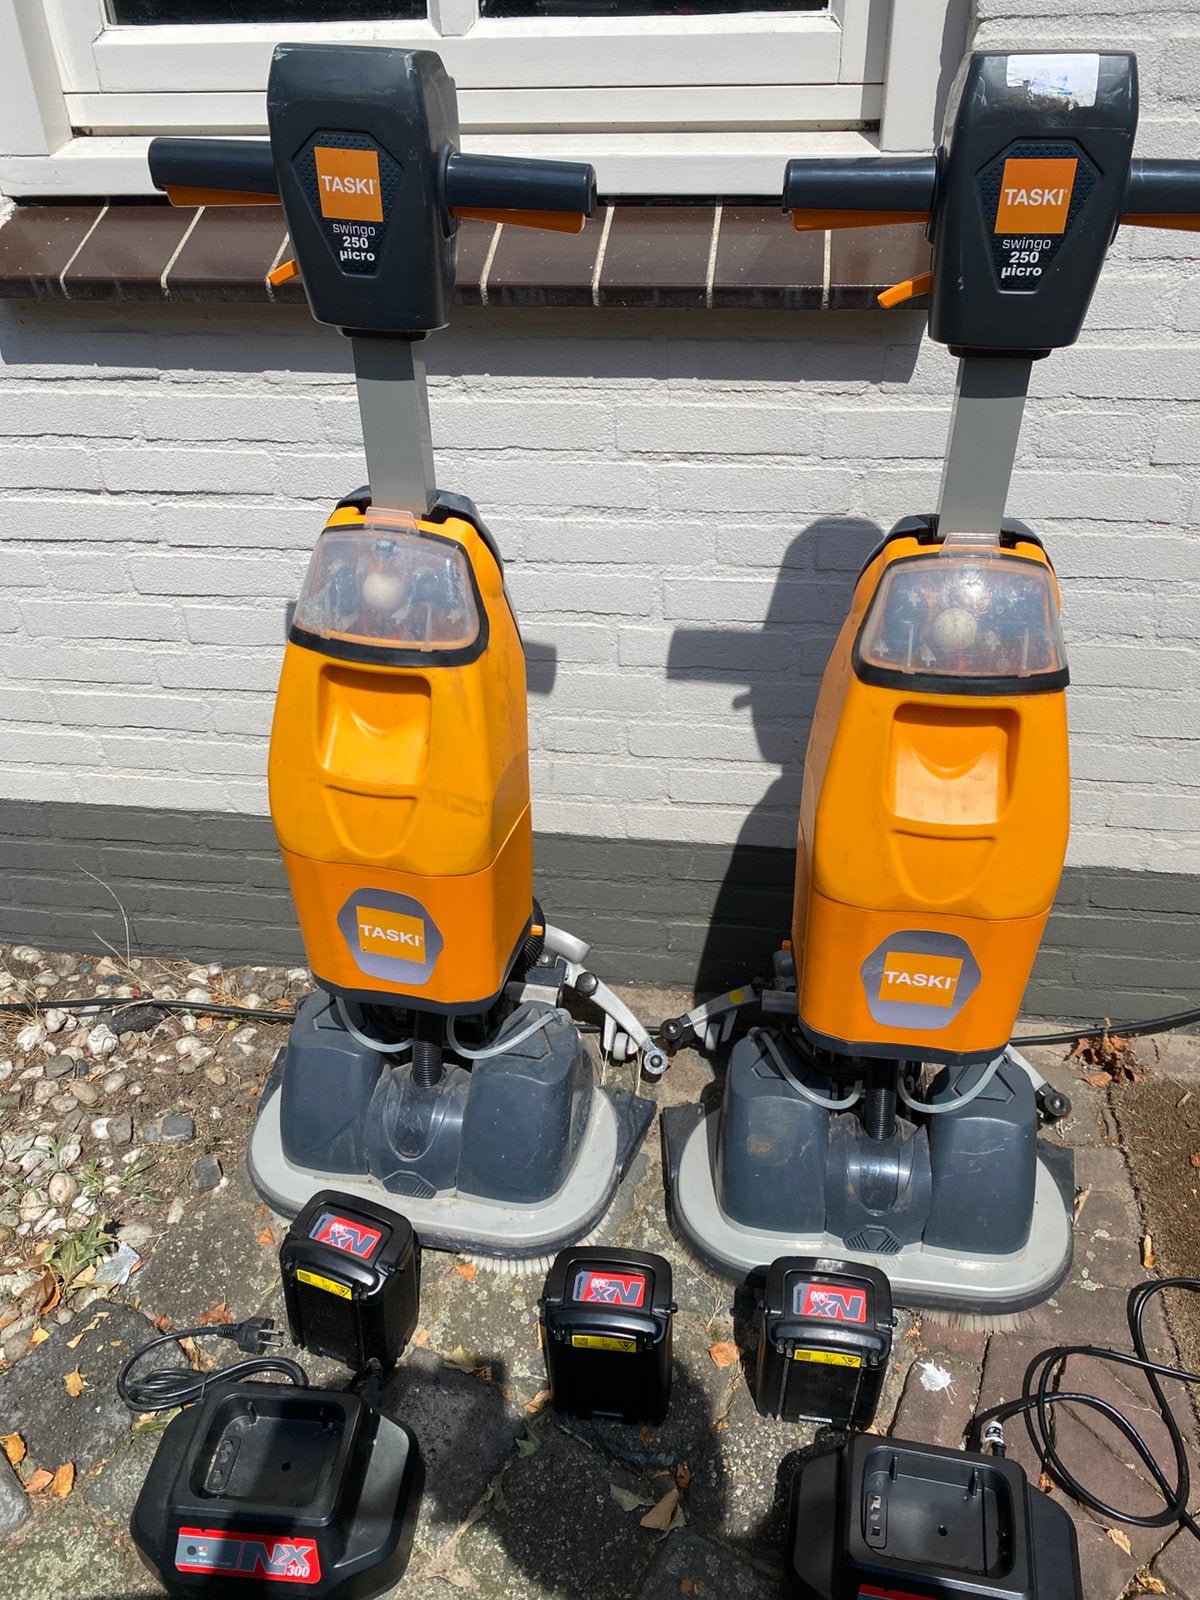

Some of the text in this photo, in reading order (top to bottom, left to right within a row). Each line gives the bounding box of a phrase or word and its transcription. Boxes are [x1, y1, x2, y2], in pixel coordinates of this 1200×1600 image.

[321, 175, 375, 195] TASKI
[1004, 188, 1066, 206] TASKI
[332, 222, 376, 237] swingo
[342, 236, 369, 249] 250
[1002, 237, 1051, 251] swingo
[1009, 251, 1040, 263] 250
[360, 924, 421, 947] TASKI
[884, 971, 952, 989] TASKI
[321, 1228, 377, 1256] NX
[590, 1277, 609, 1288] 300
[587, 1280, 643, 1305] NX
[810, 1291, 829, 1301] 300
[807, 1293, 864, 1320] NX
[238, 1541, 314, 1575] NX
[286, 1565, 310, 1578] 300
